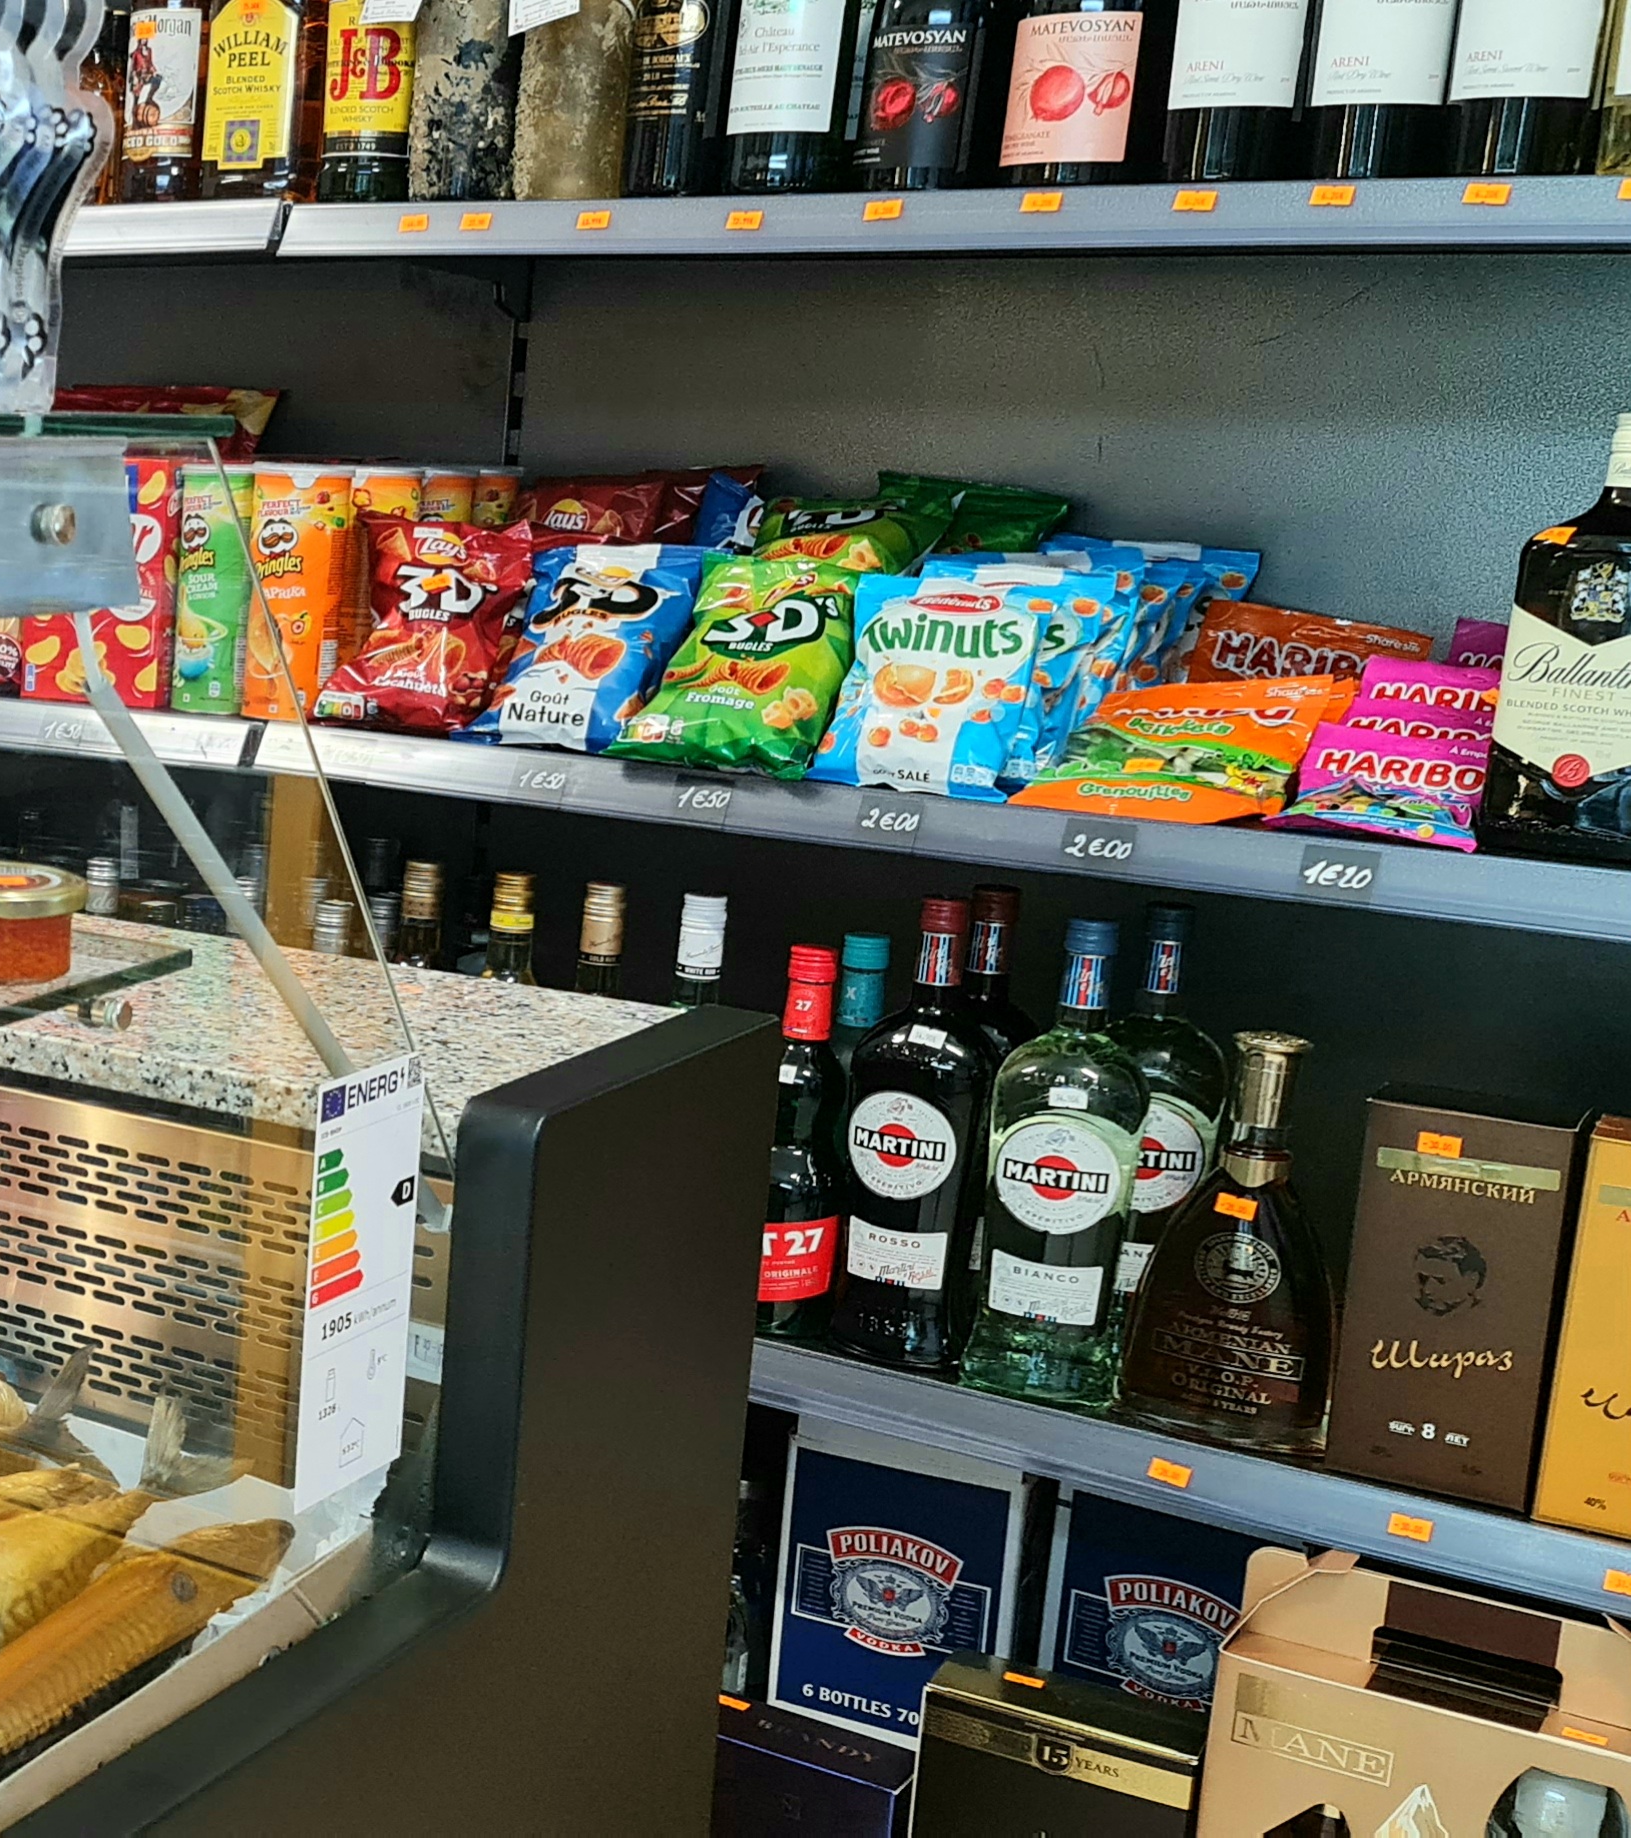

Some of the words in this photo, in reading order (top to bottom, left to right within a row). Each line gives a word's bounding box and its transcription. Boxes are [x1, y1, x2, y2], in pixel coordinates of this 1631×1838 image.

[754, 27, 794, 39] Château
[1030, 19, 1137, 37] MATEVOSYAN
[213, 30, 288, 58] WILLIAM
[762, 41, 820, 54] l'Espérance
[873, 30, 967, 49] MATEVOSYAN
[227, 51, 271, 68] PEEL
[329, 28, 401, 101] J&B
[1186, 60, 1224, 73] ARENI
[1330, 55, 1370, 69] ARENI
[1466, 50, 1506, 63] ARENI
[226, 75, 265, 83] BLENDED
[213, 86, 243, 95] SCOTCH
[245, 84, 281, 94] WHISKY
[342, 115, 373, 123] WHISKY
[359, 105, 394, 114] SCOTCH
[262, 499, 301, 509] PERFECT
[420, 537, 467, 560] Lay's
[255, 553, 302, 580] Pringles
[187, 582, 218, 592] CREAM
[188, 574, 215, 584] SOUR
[409, 608, 451, 622] BUGLES
[863, 613, 1024, 659] Twinuts
[729, 641, 773, 652] BUGLES
[530, 689, 569, 706] Goût
[685, 691, 755, 710] Fromage
[1552, 687, 1616, 703] FINEST
[507, 701, 585, 730] Nature
[1507, 698, 1559, 711] BLENDED
[1562, 703, 1608, 715] SCOTCH
[519, 769, 566, 790] 1€50
[897, 769, 931, 783] SALÉ
[1320, 748, 1485, 792] HARIBO
[678, 787, 732, 811] 1€50
[1077, 781, 1191, 802] Grenouilles
[861, 807, 920, 832] 2€00
[1064, 834, 1133, 861] 2€00
[1304, 860, 1373, 889] 1€20
[684, 966, 703, 976] WHITE
[795, 1000, 812, 1011] 27
[347, 1070, 399, 1109] ENERG
[855, 1128, 945, 1161] MARTINI
[319, 1157, 326, 1171] A
[319, 1178, 325, 1192] B
[1005, 1161, 1109, 1193] MARTINI
[1390, 1168, 1537, 1205] АРМЯНСКИЙ
[402, 1180, 411, 1199] D
[784, 1227, 825, 1257] 27
[868, 1232, 922, 1250] ROSSO
[1013, 1266, 1081, 1284] BIANCO
[322, 1312, 352, 1341] 1905
[1173, 1321, 1292, 1355] ARMENIAN
[1164, 1335, 1295, 1376] MANE
[1370, 1339, 1514, 1379] Шираз
[1172, 1372, 1272, 1405] ORIGINAL
[1421, 1423, 1436, 1440] 8
[1444, 1433, 1470, 1447] ЛЕТ
[839, 1533, 950, 1575] POLIAKOV
[852, 1601, 891, 1617] PREMIUM
[894, 1611, 923, 1624] VODKA
[1119, 1582, 1236, 1630] POLIAKOV
[856, 1631, 914, 1653] VODKA
[1174, 1665, 1204, 1680] VODKA
[802, 1684, 814, 1697] 6
[819, 1687, 892, 1718] BOTTLES
[897, 1708, 919, 1726] 70
[1042, 1745, 1069, 1766] 15
[1075, 1757, 1120, 1778] YEARS
